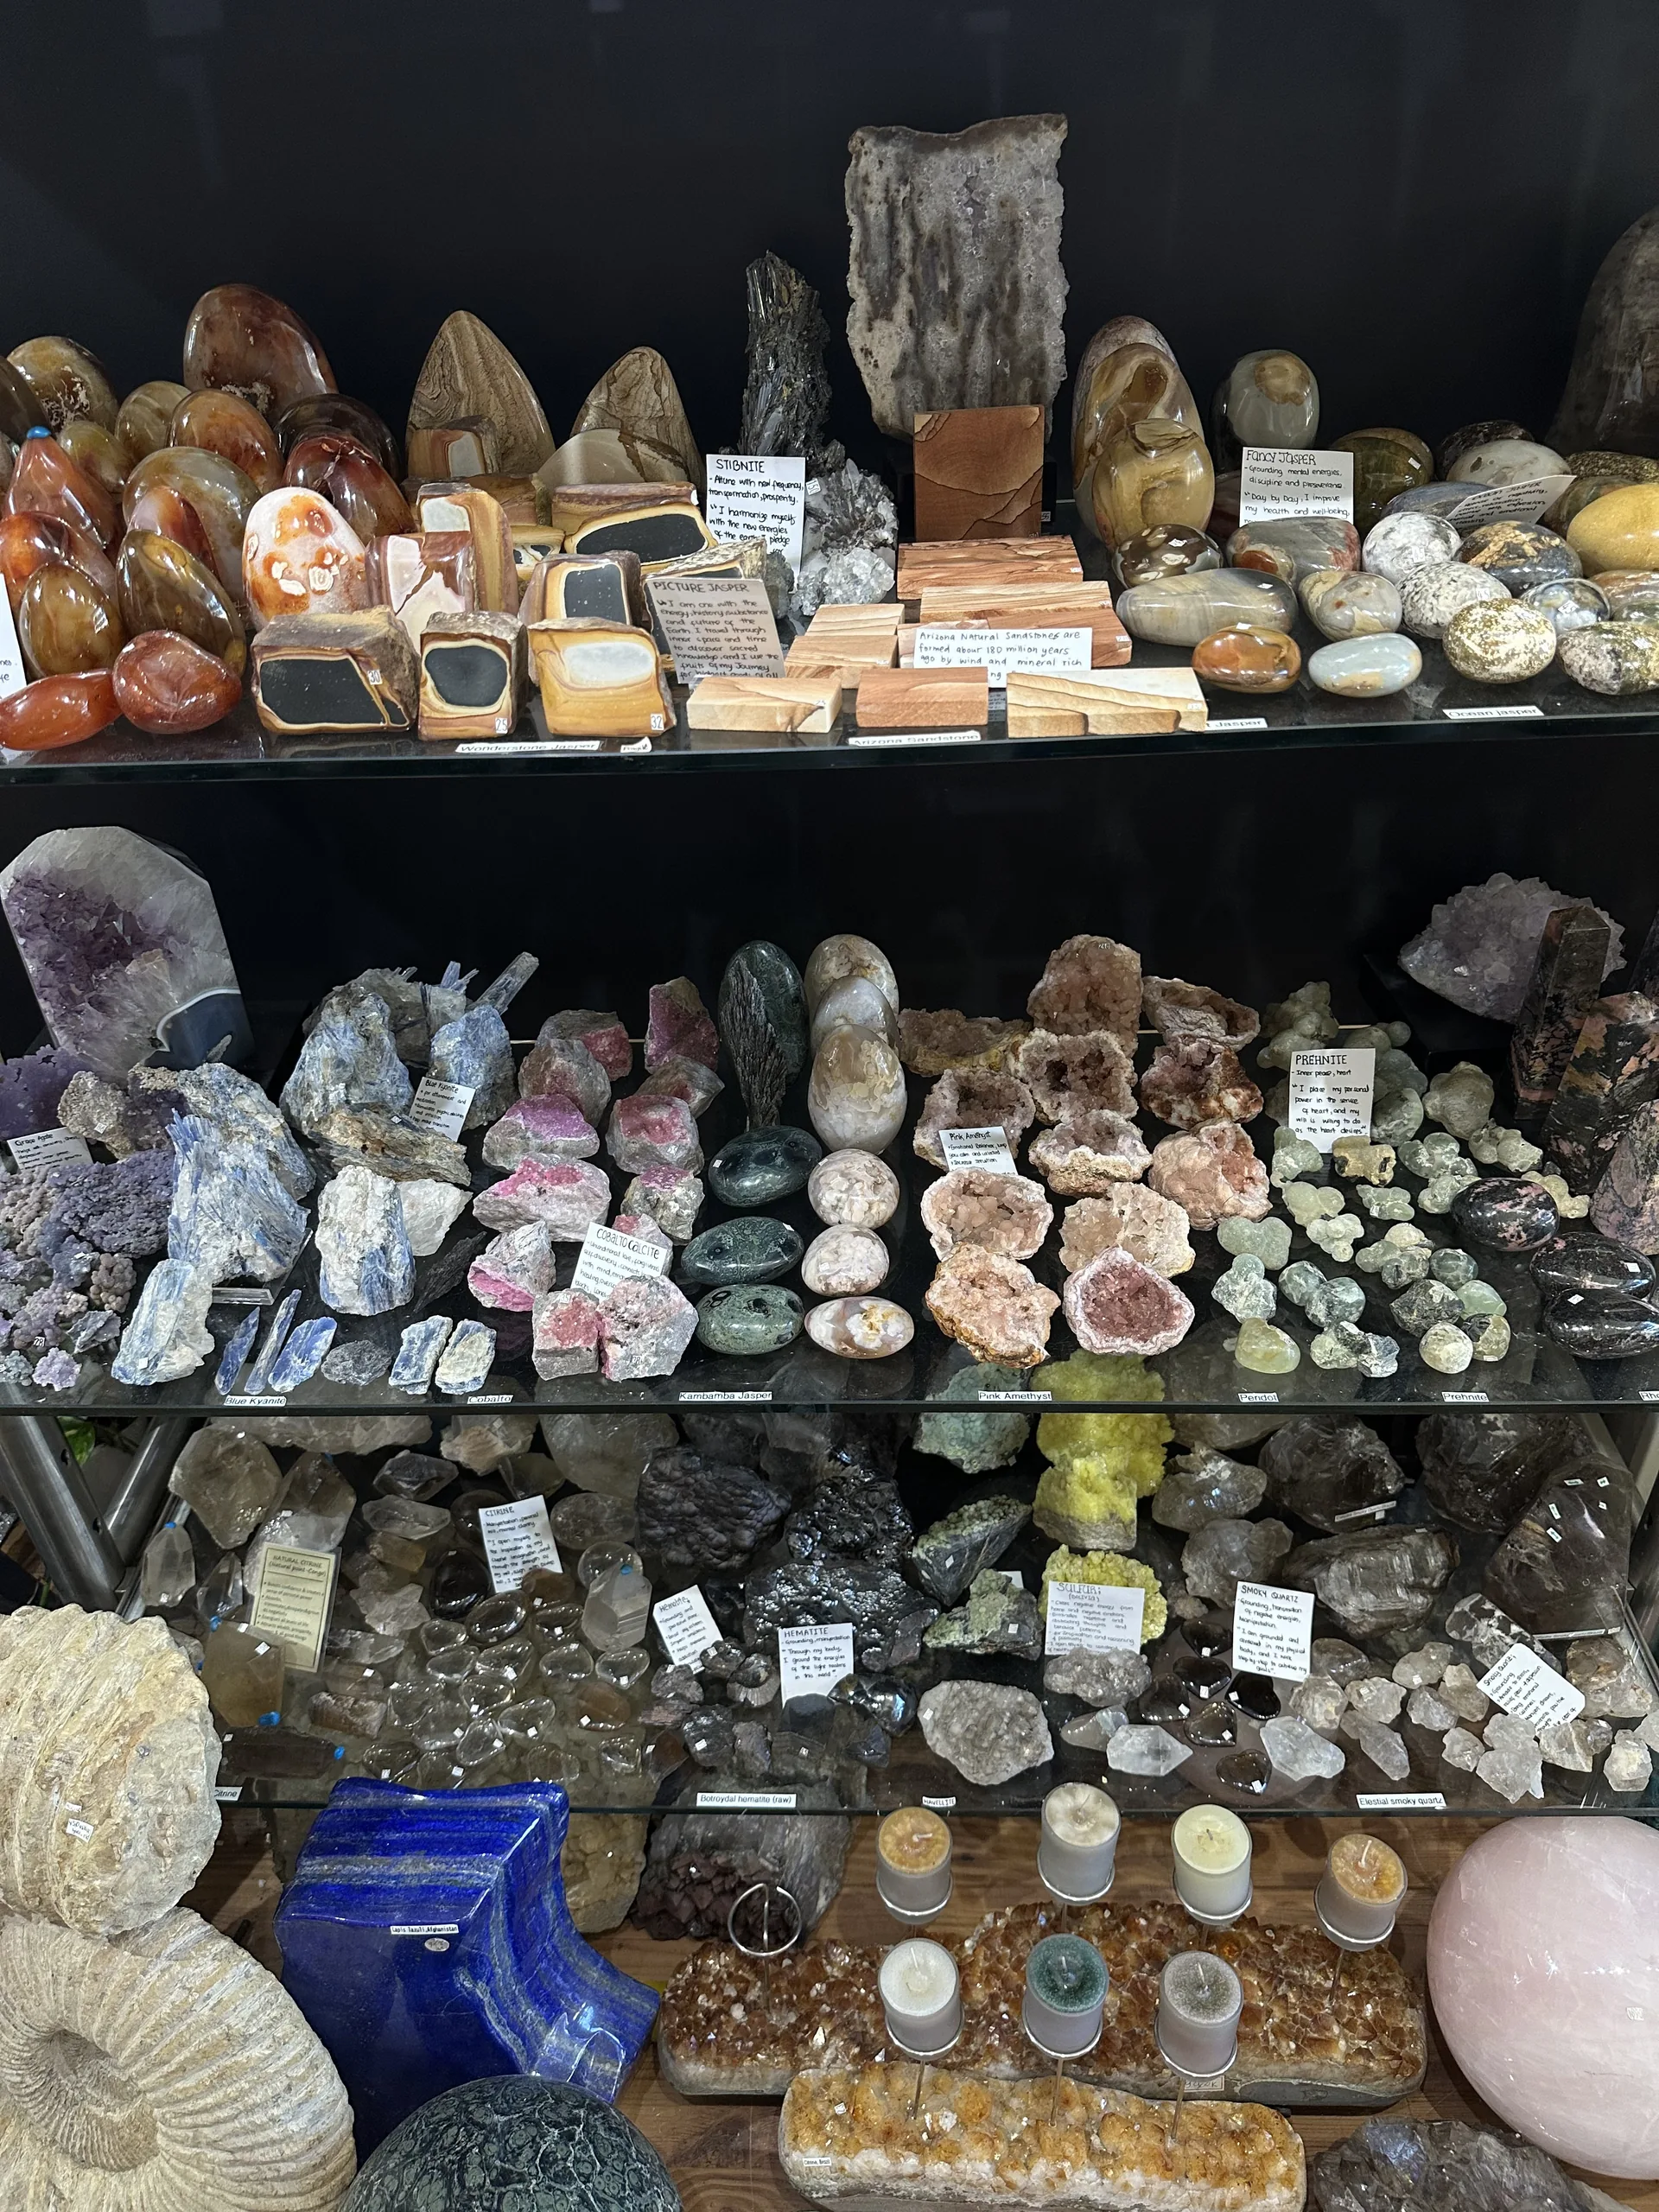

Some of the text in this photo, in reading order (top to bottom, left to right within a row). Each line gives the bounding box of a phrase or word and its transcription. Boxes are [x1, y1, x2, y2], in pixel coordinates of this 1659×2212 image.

[716, 459, 764, 473] STIBNITE
[1249, 477, 1282, 486] discipline
[1271, 494, 1280, 504] by
[1313, 495, 1340, 504] improve
[1245, 505, 1257, 514] my
[772, 514, 796, 525] myself
[728, 519, 740, 529] the
[759, 525, 787, 536] energies
[770, 537, 790, 547] pledge
[653, 582, 750, 593] PICTURE JASPER
[919, 644, 950, 652] formed
[1042, 647, 1069, 658] years
[920, 655, 935, 664] ago
[941, 656, 951, 664] by
[369, 671, 379, 683] 30
[497, 718, 507, 731] 25
[652, 715, 663, 728] 32
[1296, 1054, 1347, 1065] PREHNITE
[485, 1506, 515, 1516] CITRINE
[1241, 1585, 1299, 1603] SMOKY QUARTZ
[785, 1627, 829, 1637] HEMATITE
[701, 1794, 736, 1802] Botroydal
[1359, 1797, 1389, 1806] Elestial
[1390, 1797, 1415, 1807] smoky
